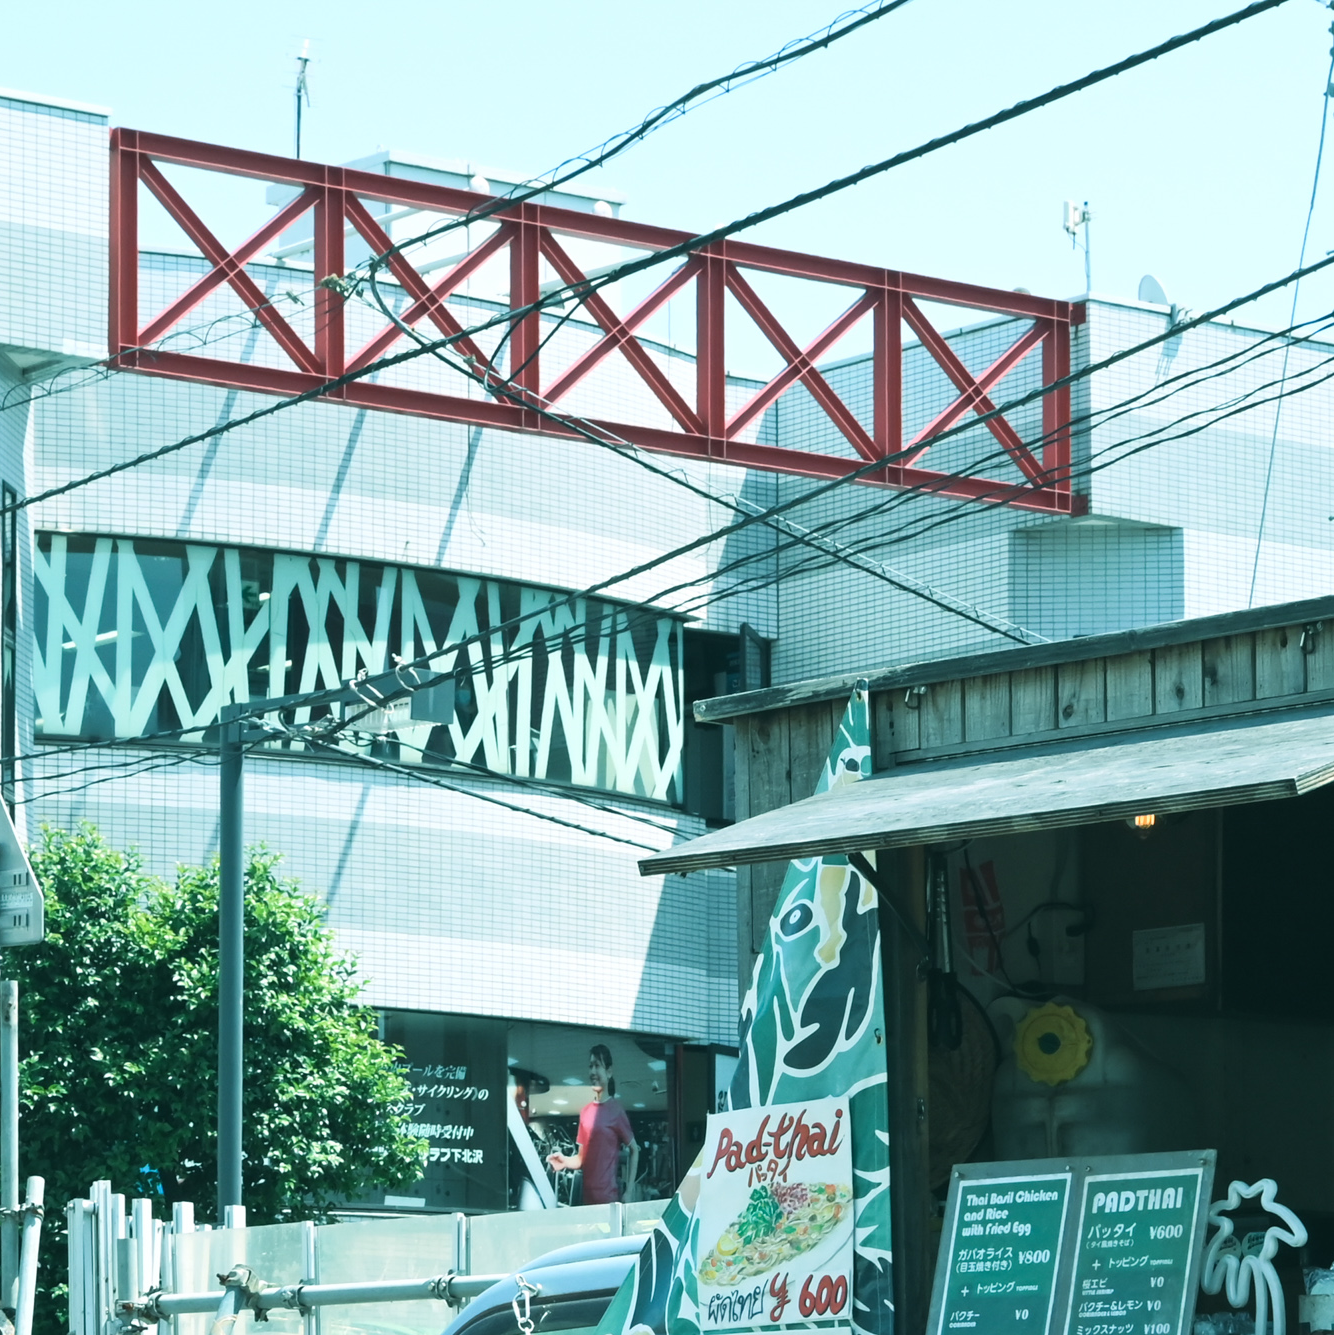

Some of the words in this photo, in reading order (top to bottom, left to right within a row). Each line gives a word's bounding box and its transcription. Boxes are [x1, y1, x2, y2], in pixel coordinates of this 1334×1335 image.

[967, 1193, 988, 1206] Thai
[990, 1191, 1014, 1204] Basil
[1015, 1190, 1058, 1203] Chicken
[1092, 1187, 1183, 1214] PADTHAI
[964, 1209, 984, 1221] and
[986, 1208, 1008, 1220] Rice
[962, 1224, 983, 1237] with
[986, 1222, 1011, 1235] Fried
[1013, 1221, 1031, 1236] Egg
[1087, 1222, 1137, 1239] パッタイ
[1149, 1224, 1183, 1239] ¥600
[1018, 1249, 1050, 1264] ¥800
[1108, 1255, 1149, 1268] トッピング
[977, 1281, 1015, 1294] トッピング
[1150, 1276, 1164, 1288] ¥0
[1015, 1309, 1029, 1320] ¥0
[1077, 1323, 1134, 1335] ミックスナッツ
[1144, 1323, 1170, 1335] ¥100
